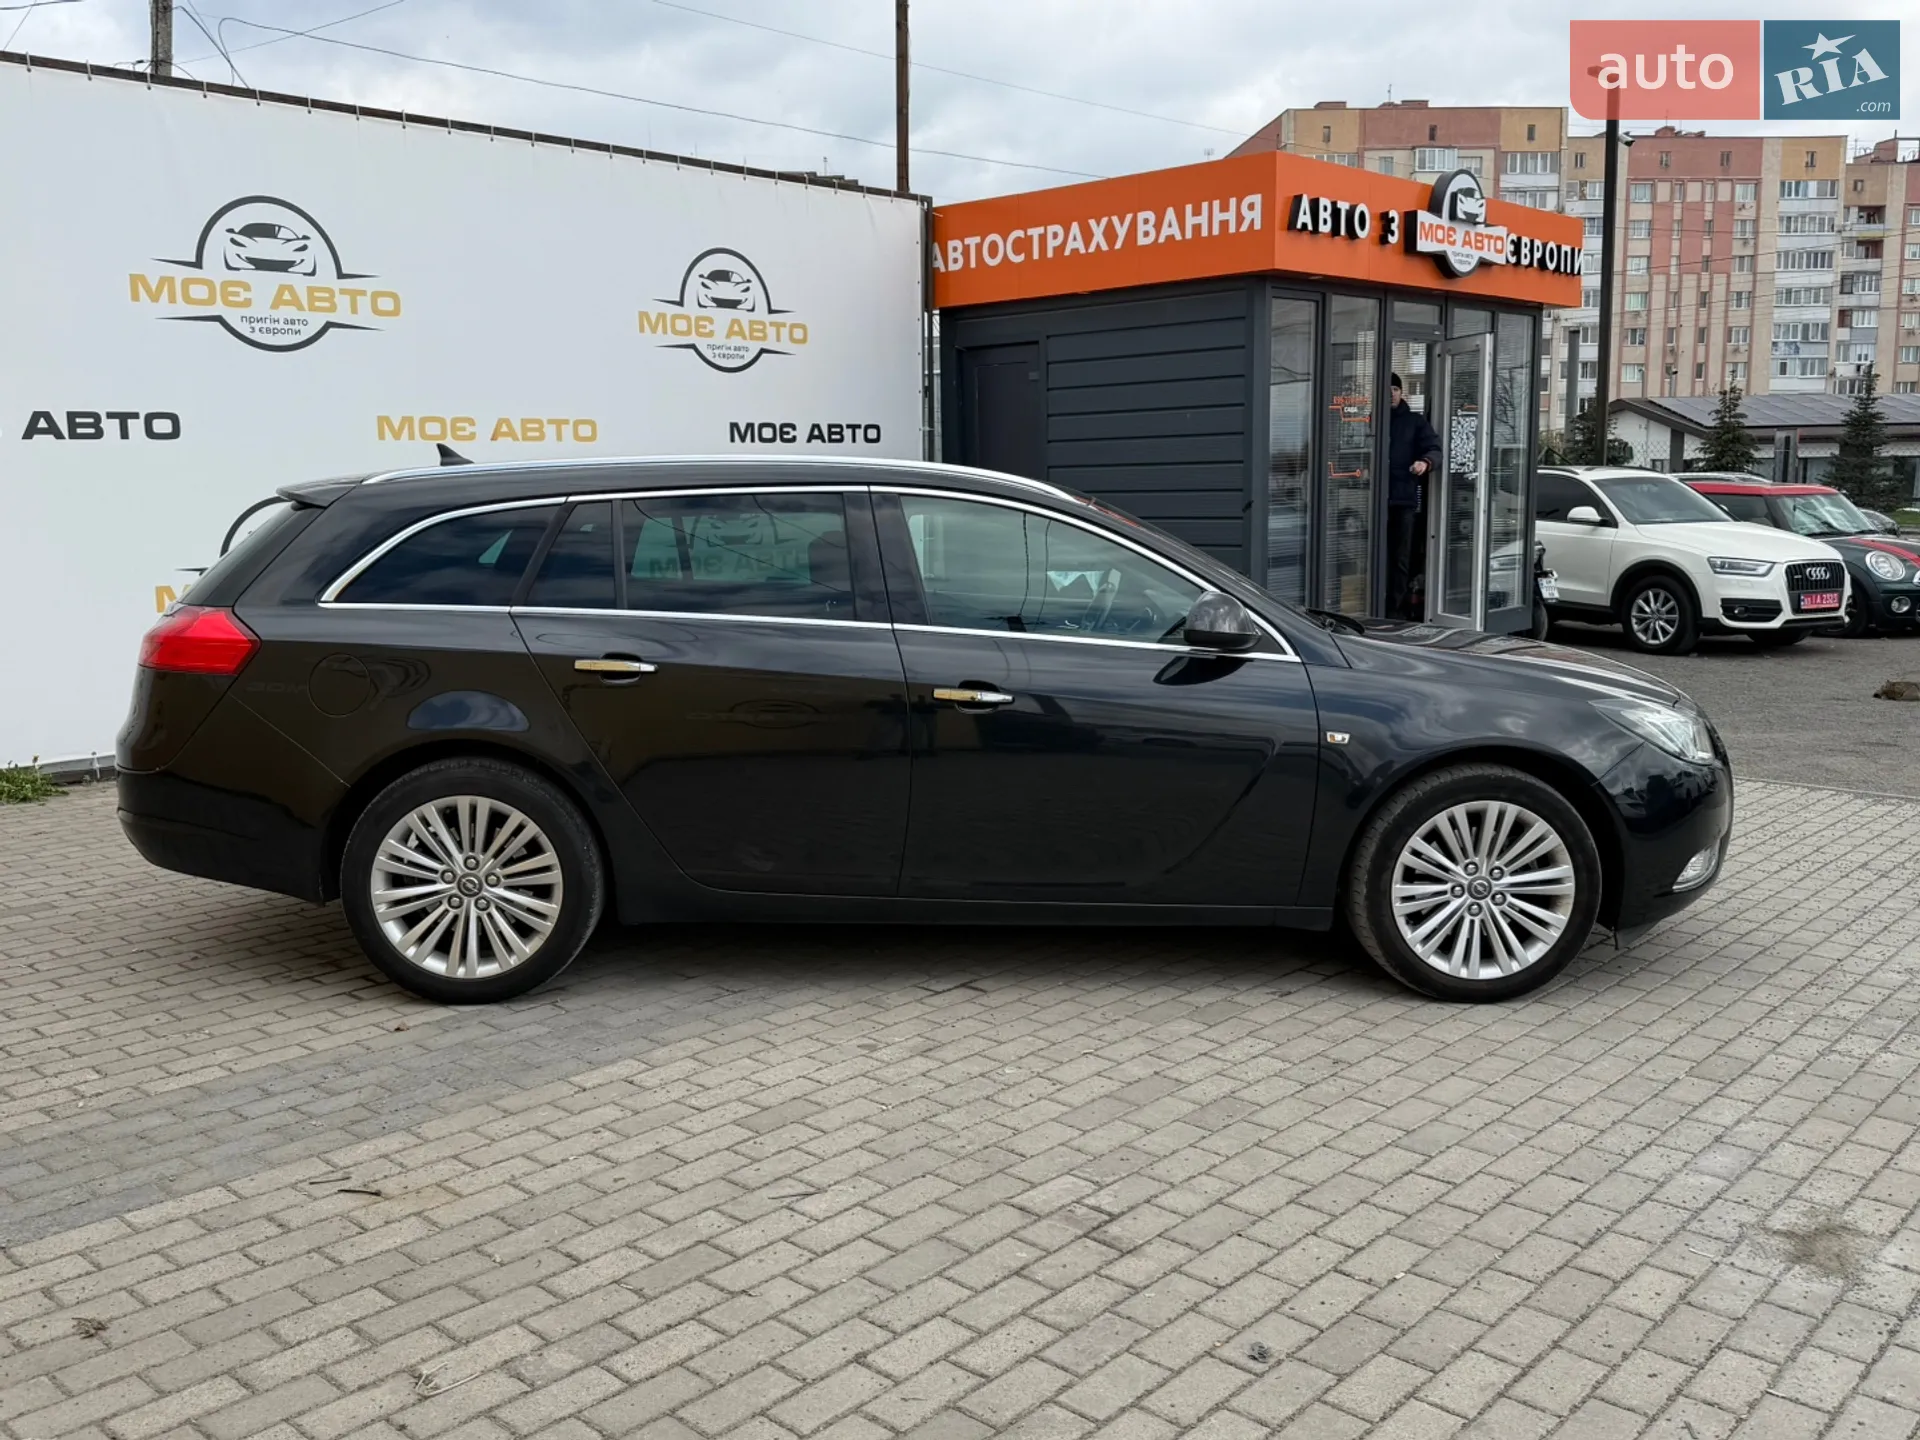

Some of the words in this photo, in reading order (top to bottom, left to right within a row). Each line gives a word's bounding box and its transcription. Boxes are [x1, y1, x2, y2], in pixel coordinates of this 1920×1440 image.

[932, 192, 1262, 273] АВТОСТРАХУВАННЯ
[1294, 193, 1371, 239] АВТО
[1506, 233, 1583, 275] ЄВРОПИ
[1419, 221, 1457, 246] МОЄ
[1461, 231, 1505, 255] АВТО
[128, 273, 253, 308] МОЄ
[270, 283, 402, 318] АВТО
[240, 315, 280, 325] пригін
[283, 318, 309, 327] авто
[258, 326, 302, 336] європи
[638, 310, 715, 339] МОЄ
[725, 318, 809, 345] АВТО
[21, 410, 181, 441] АВТО
[376, 415, 476, 442] МОЄ
[490, 416, 598, 443] АВТО
[729, 421, 797, 443] МОЄ
[805, 423, 882, 444] АВТО
